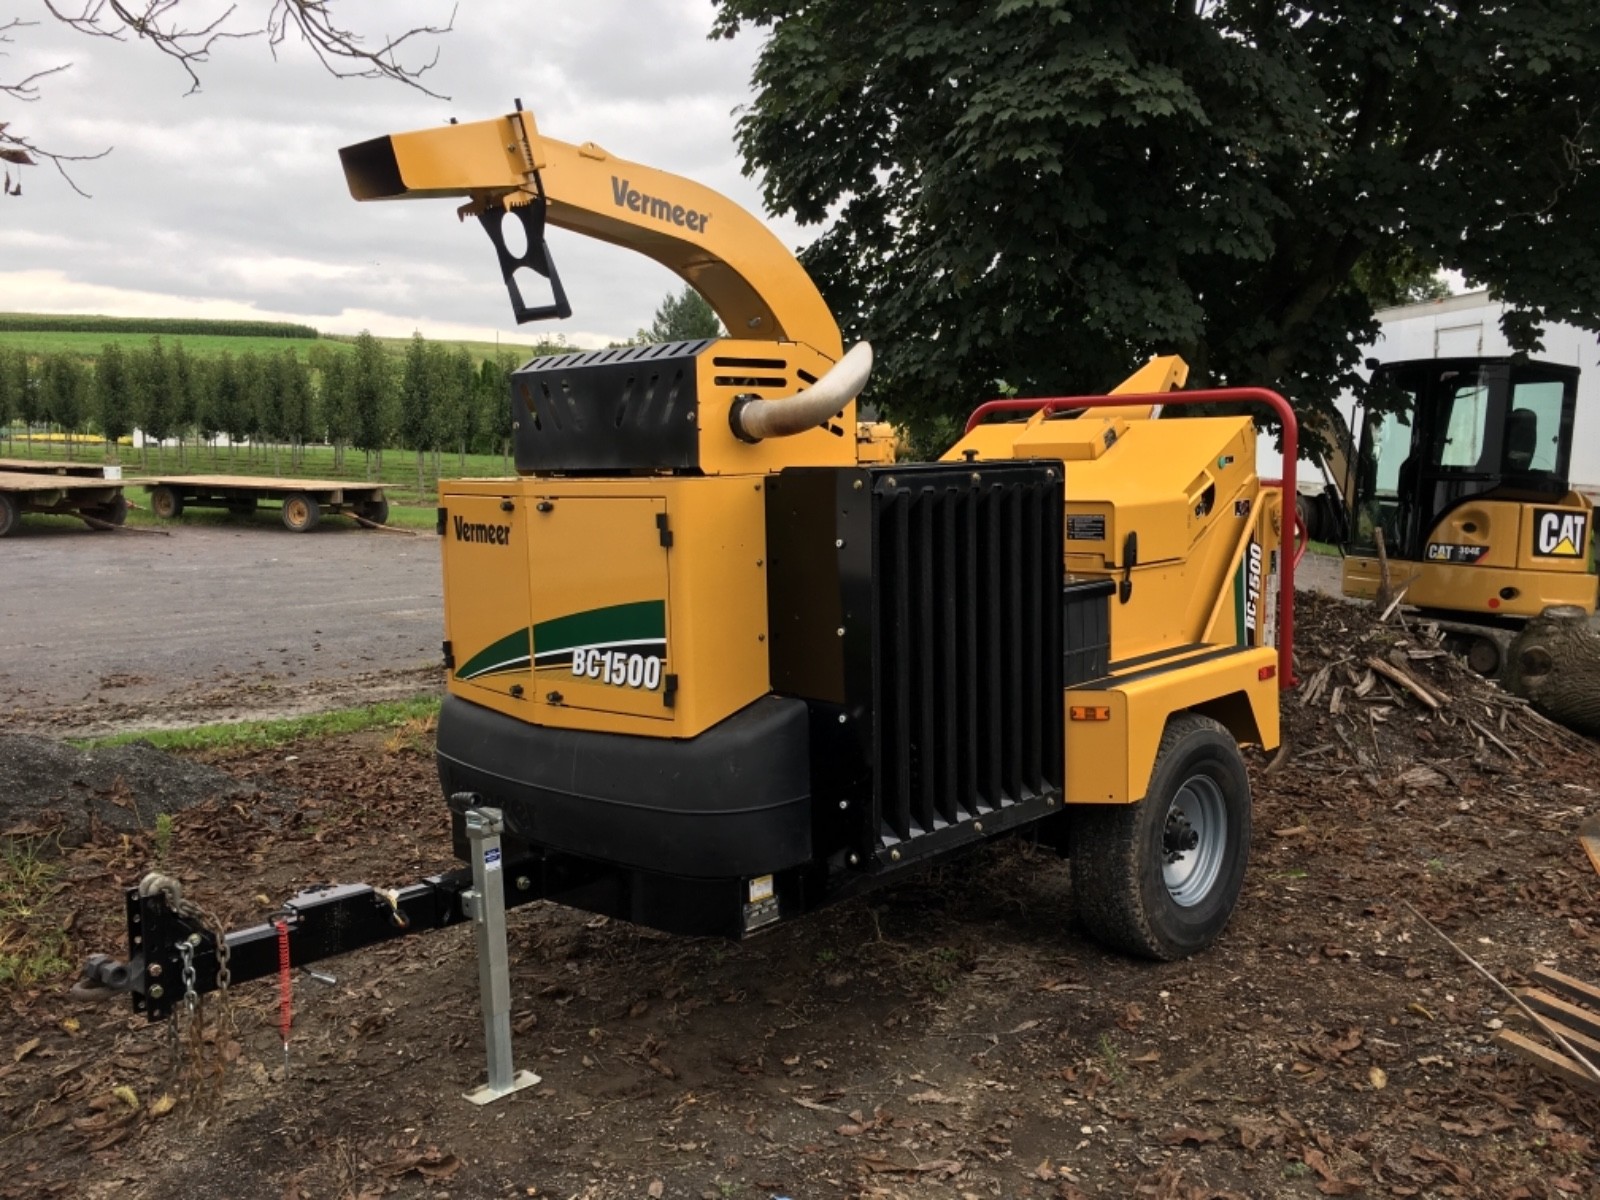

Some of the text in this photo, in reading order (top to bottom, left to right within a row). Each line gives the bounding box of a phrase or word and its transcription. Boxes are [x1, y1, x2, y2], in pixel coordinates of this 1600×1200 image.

[611, 175, 708, 234] Vermeer
[453, 515, 510, 546] Vermeer
[1539, 512, 1585, 555] CAT
[1429, 544, 1454, 560] CAT
[572, 648, 661, 690] BC1500
